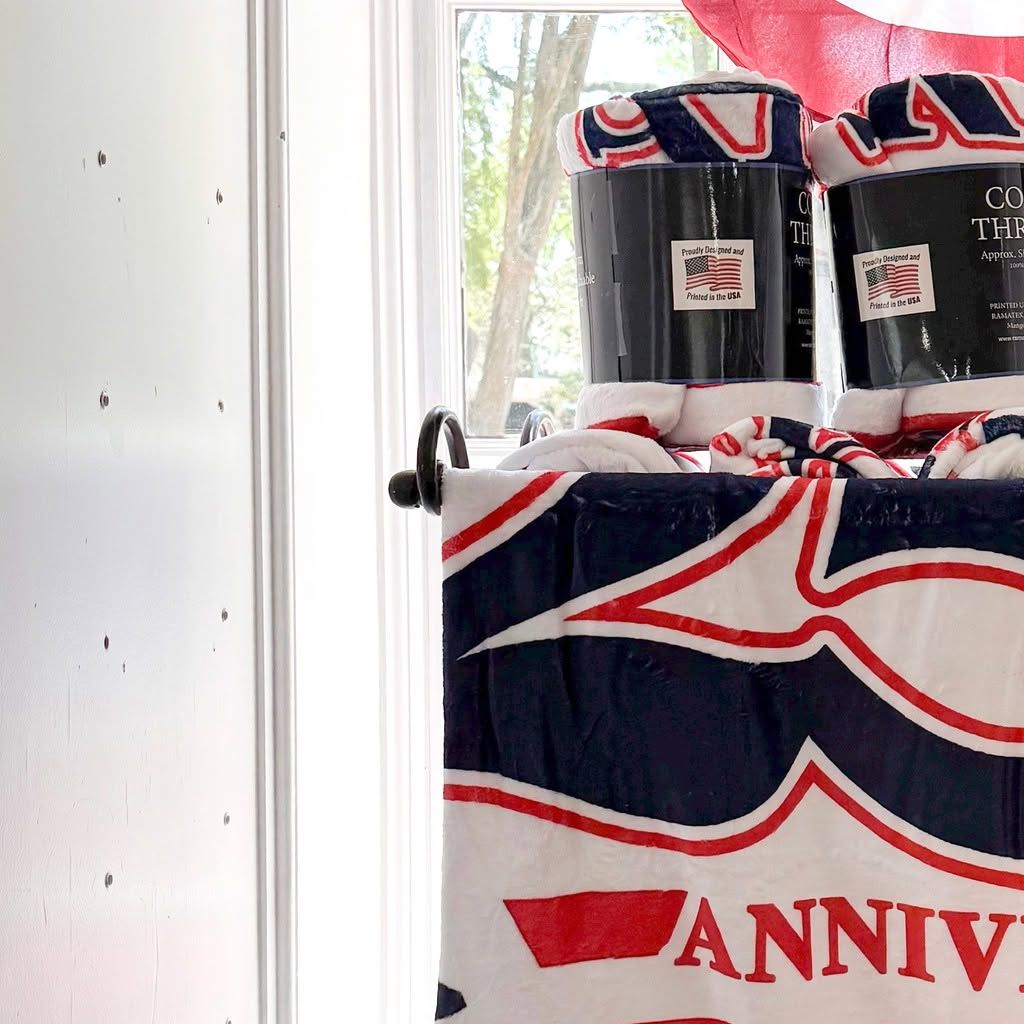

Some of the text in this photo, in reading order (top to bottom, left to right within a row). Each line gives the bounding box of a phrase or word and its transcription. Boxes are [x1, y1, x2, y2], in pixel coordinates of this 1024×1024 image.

[682, 246, 703, 256] Proudly
[981, 250, 1016, 262] Approx.
[883, 254, 908, 263] Designed
[687, 292, 708, 301] Printed
[727, 291, 741, 300] USA
[869, 301, 889, 310] Printed
[907, 296, 920, 305] USA
